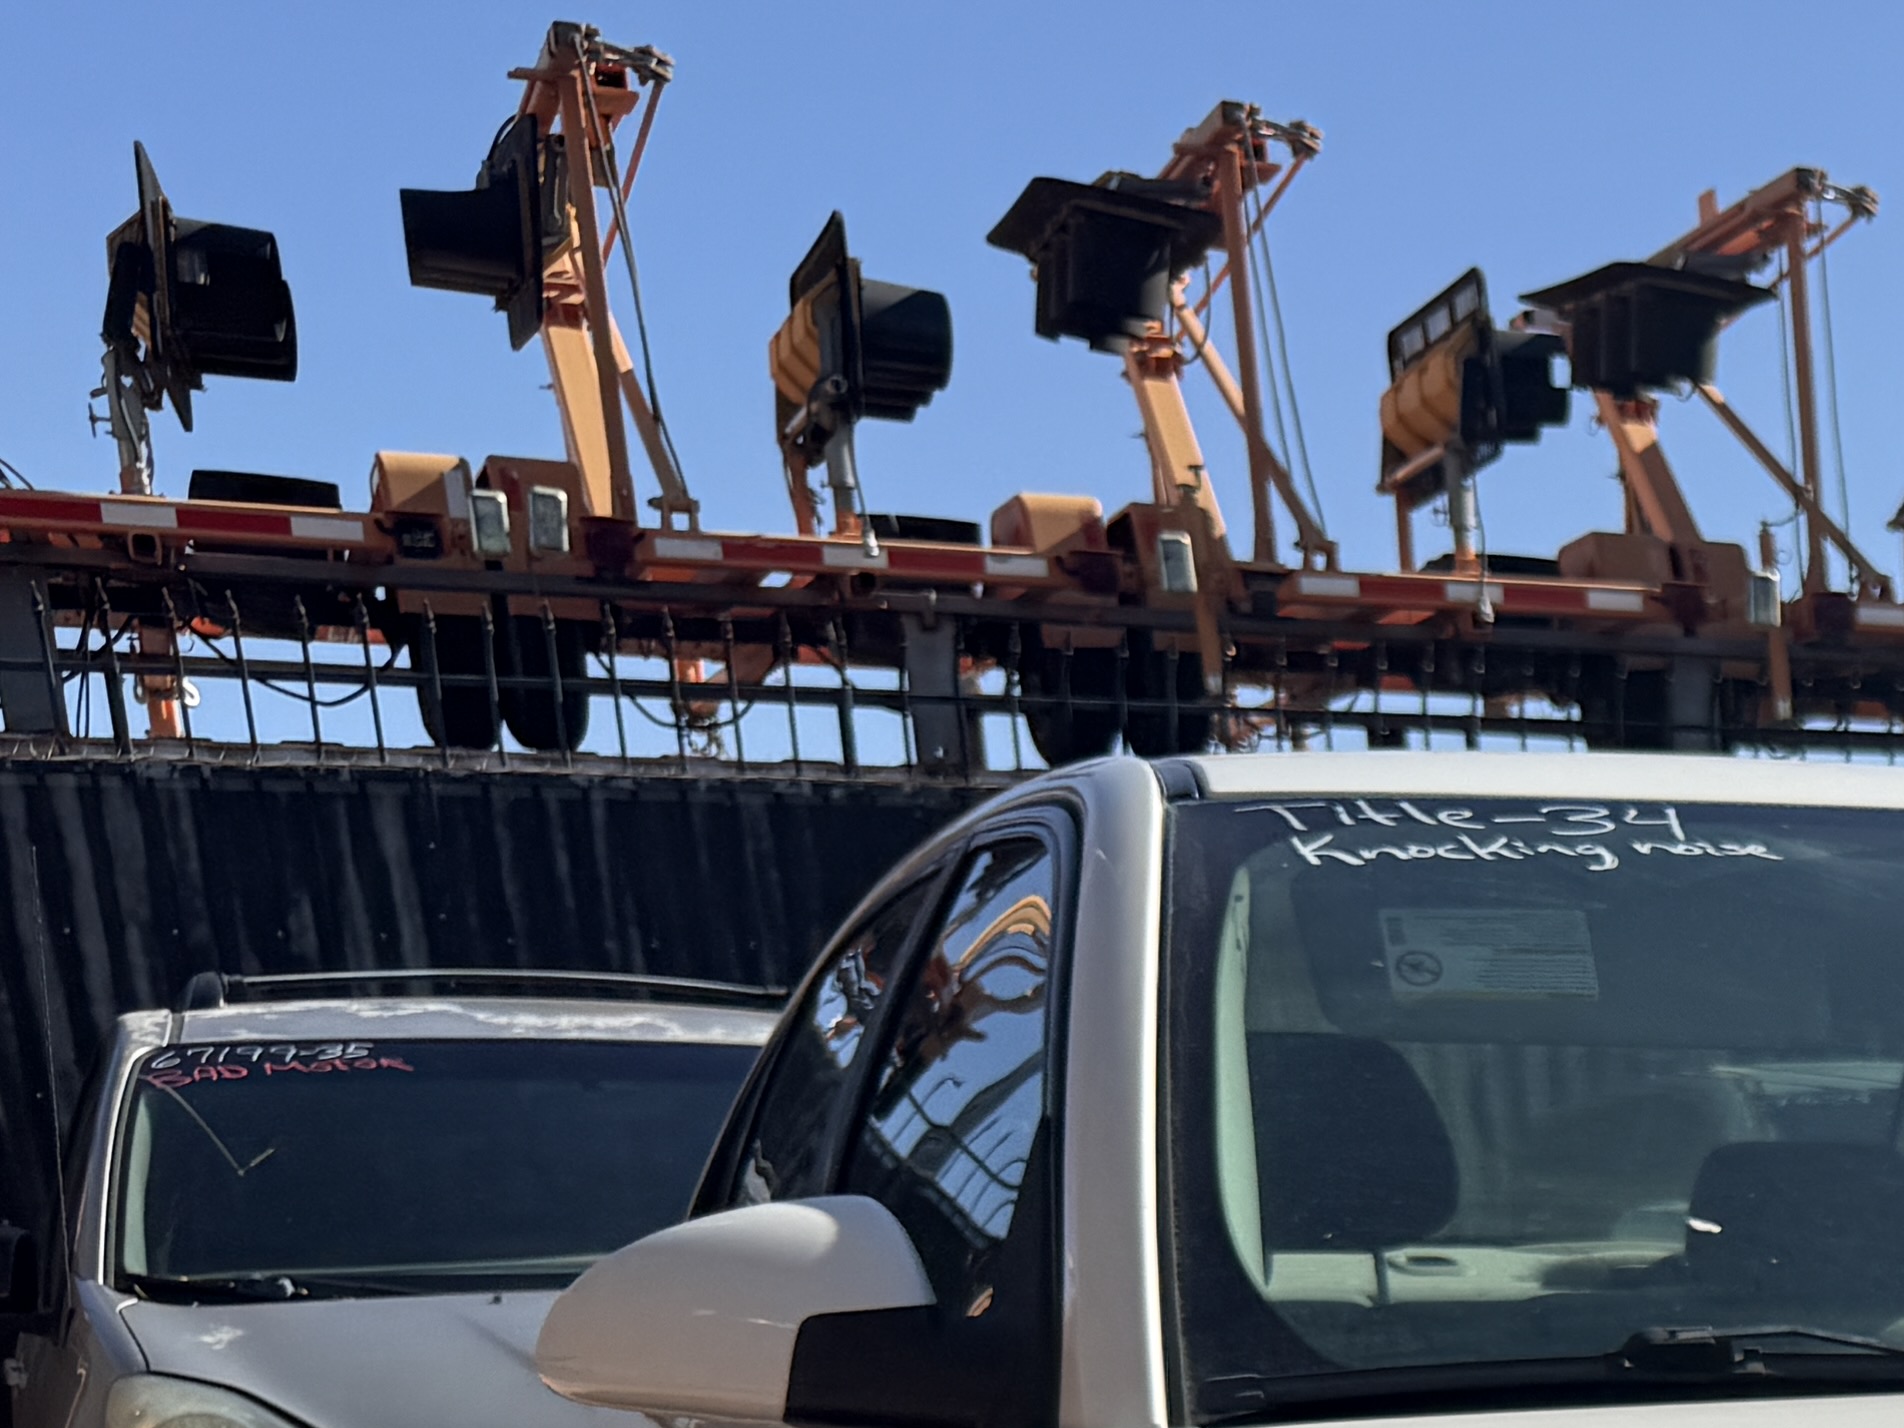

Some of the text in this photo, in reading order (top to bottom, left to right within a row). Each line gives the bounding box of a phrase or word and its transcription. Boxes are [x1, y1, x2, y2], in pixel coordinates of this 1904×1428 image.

[1233, 799, 1687, 841] Title-34
[1291, 834, 1784, 872] Knocking noise
[144, 1064, 249, 1088] BAD
